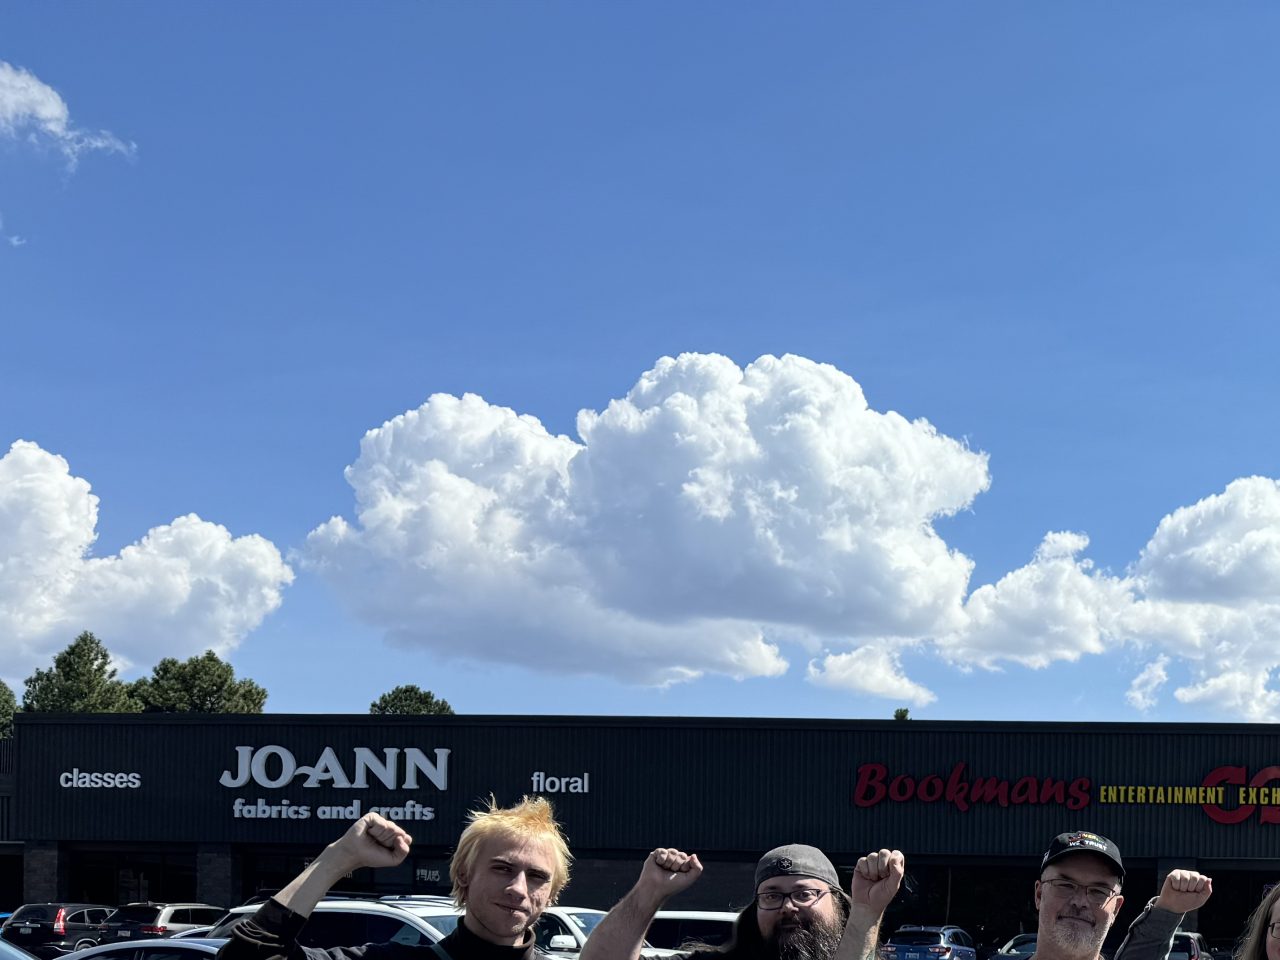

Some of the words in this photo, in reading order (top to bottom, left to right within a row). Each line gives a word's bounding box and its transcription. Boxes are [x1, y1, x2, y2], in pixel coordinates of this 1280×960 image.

[60, 768, 141, 788] classes
[531, 771, 589, 793] floral
[854, 762, 1090, 811] Bookmans
[1100, 786, 1224, 804] ENTERTAINMENT
[233, 798, 311, 819] fabrics
[317, 800, 361, 820] and
